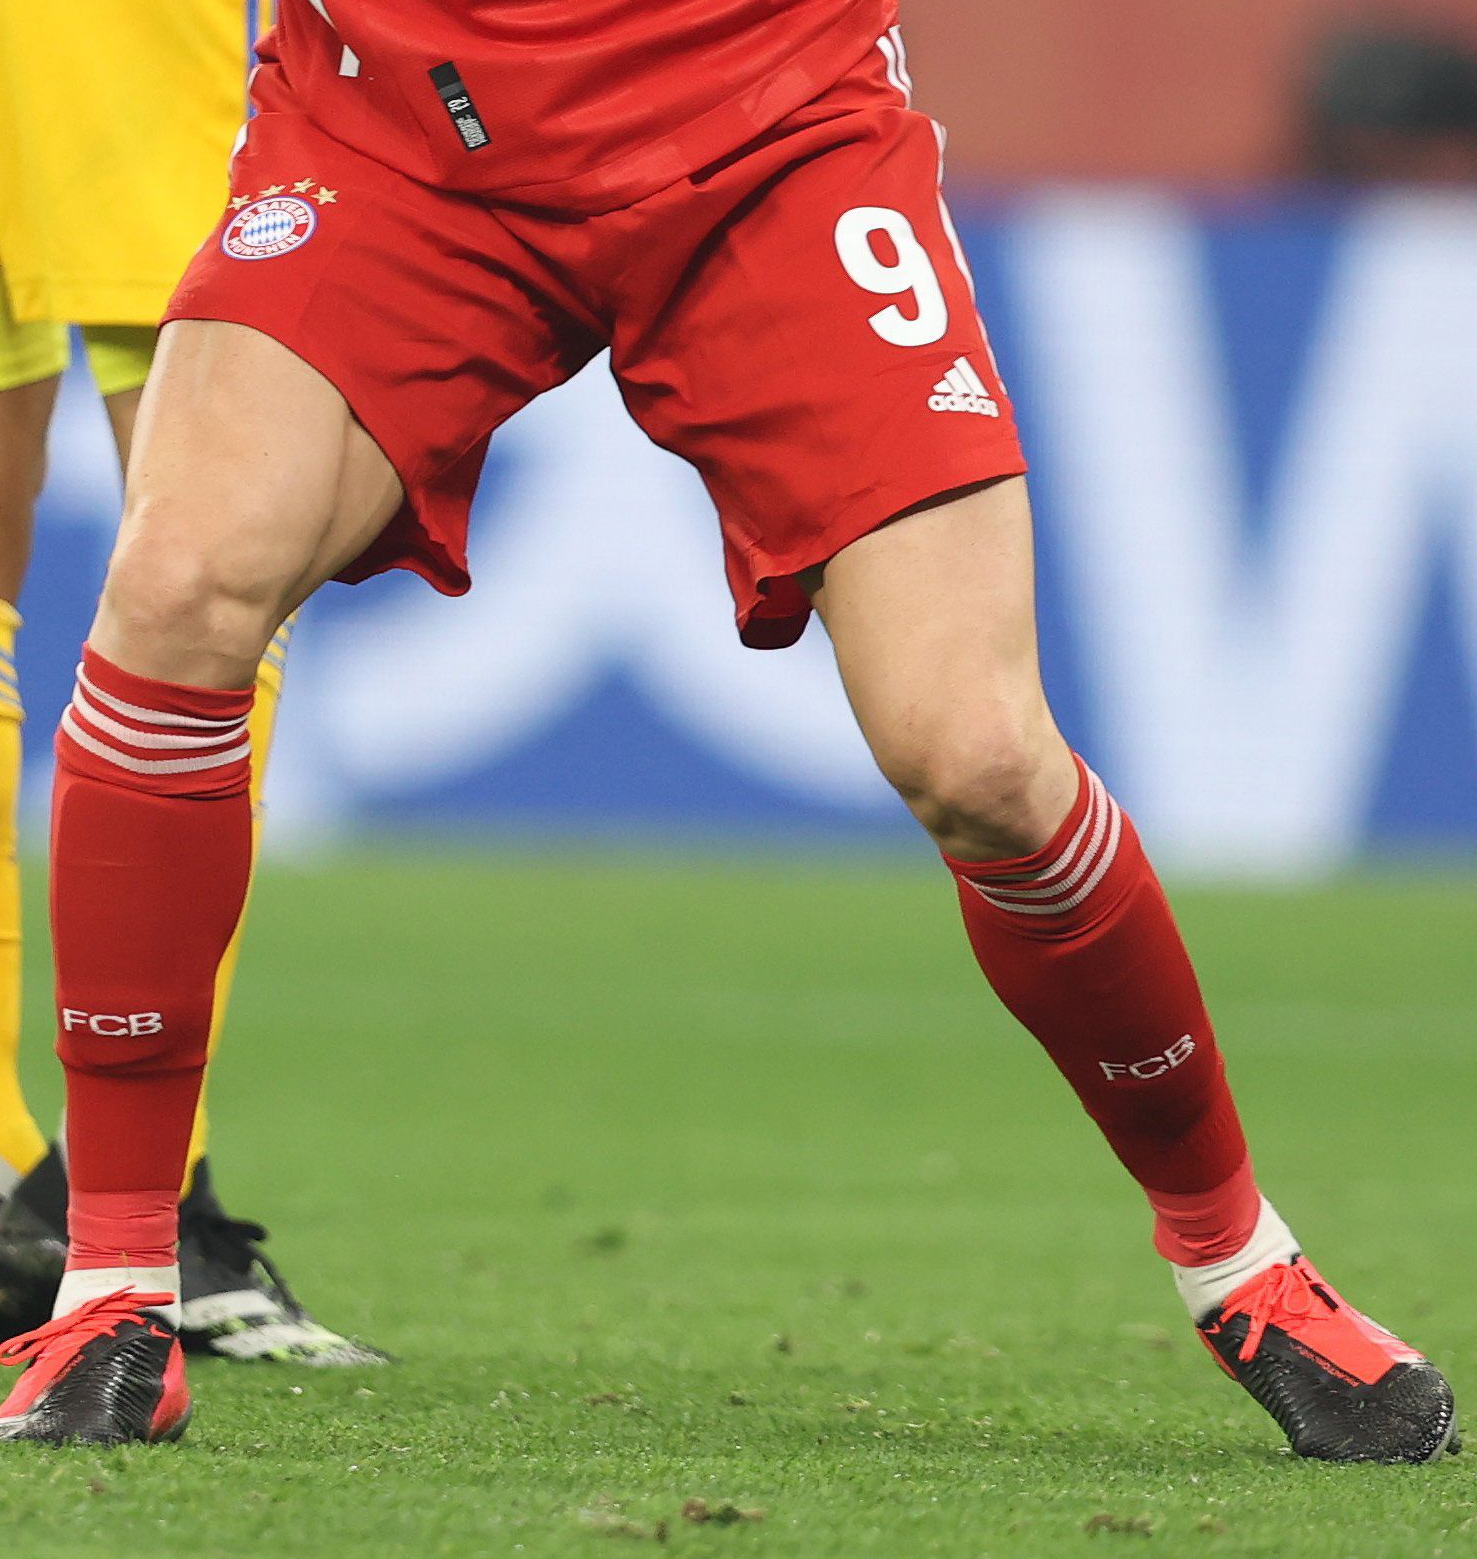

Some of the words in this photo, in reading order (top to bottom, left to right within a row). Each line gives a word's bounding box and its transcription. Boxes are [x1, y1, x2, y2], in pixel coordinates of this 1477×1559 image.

[256, 200, 310, 226] BAYERN
[834, 206, 950, 348] 9
[927, 394, 999, 418] adidas
[62, 1007, 164, 1037] FCB
[1098, 1033, 1196, 1081] FCB
